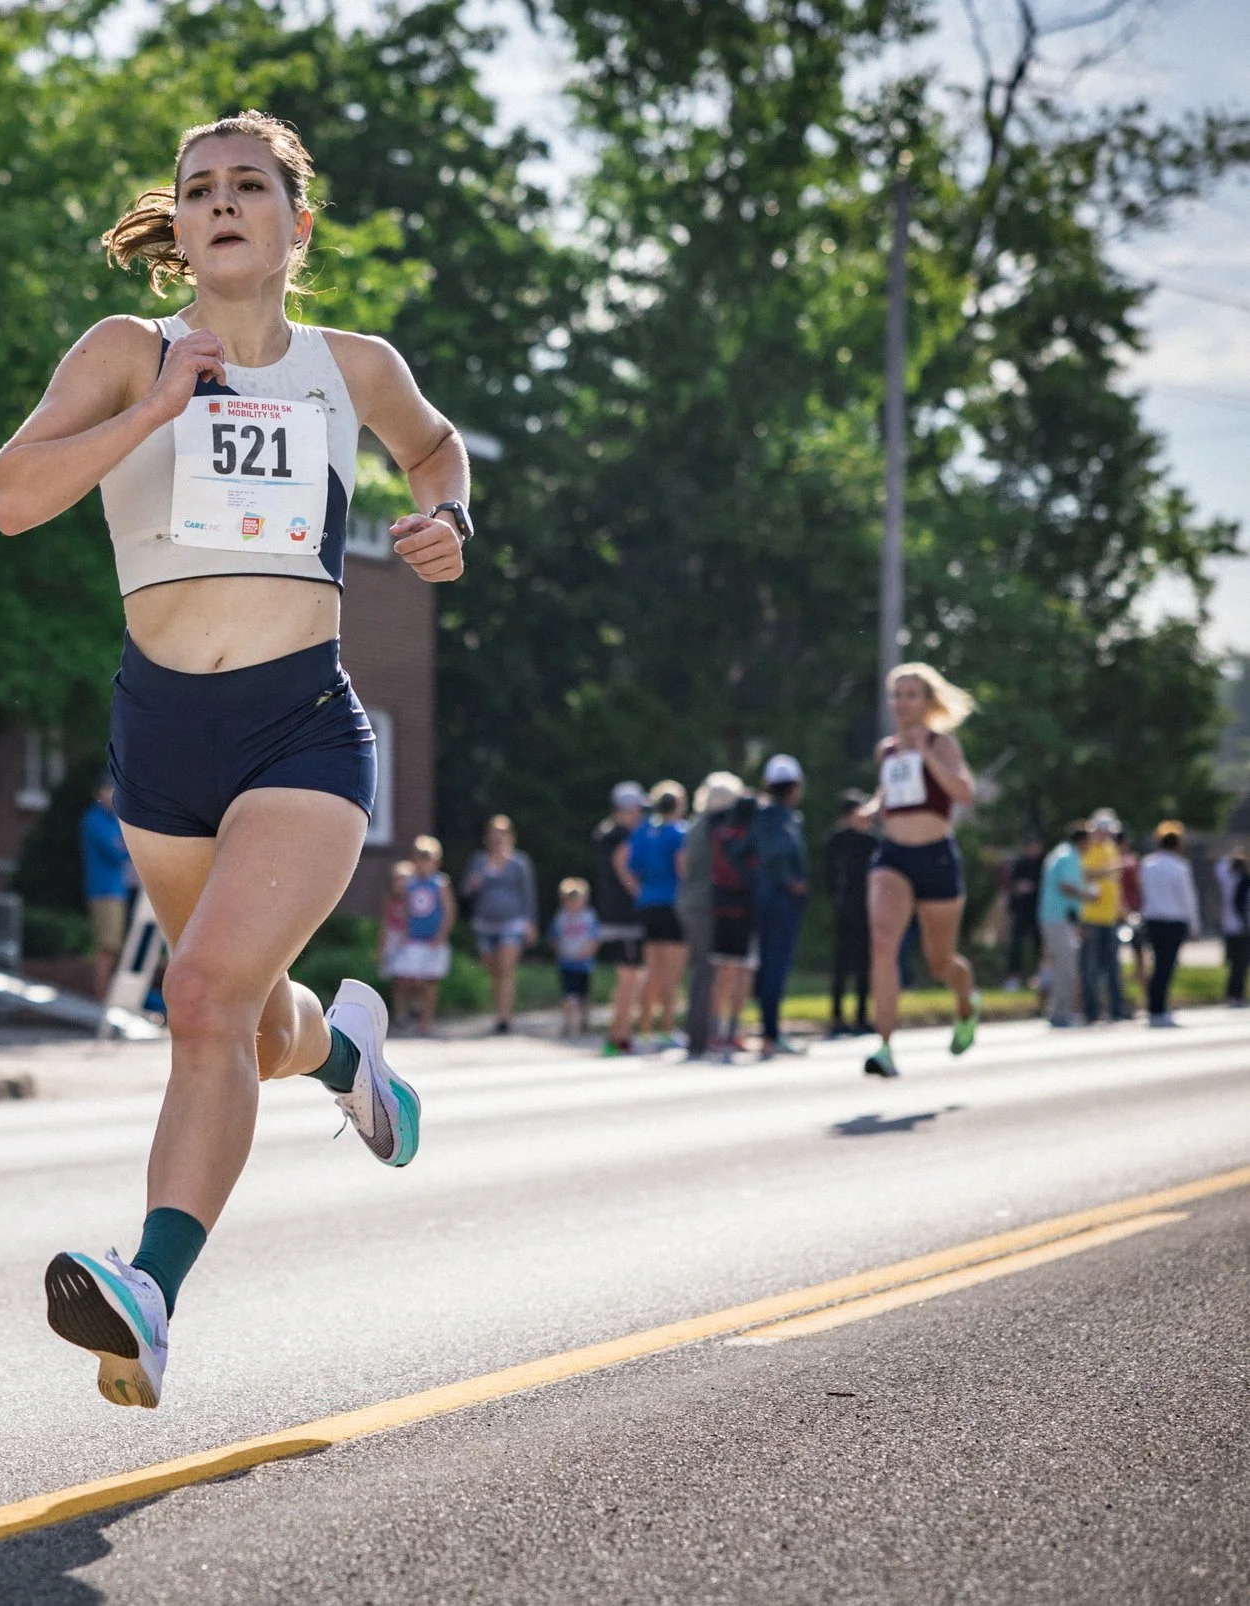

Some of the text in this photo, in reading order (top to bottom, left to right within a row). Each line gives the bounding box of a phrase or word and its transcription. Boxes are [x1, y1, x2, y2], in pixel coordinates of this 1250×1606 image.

[227, 401, 259, 410] DIEMER
[261, 403, 279, 411] RUN
[228, 409, 268, 419] MOBILITY
[212, 423, 292, 478] 521
